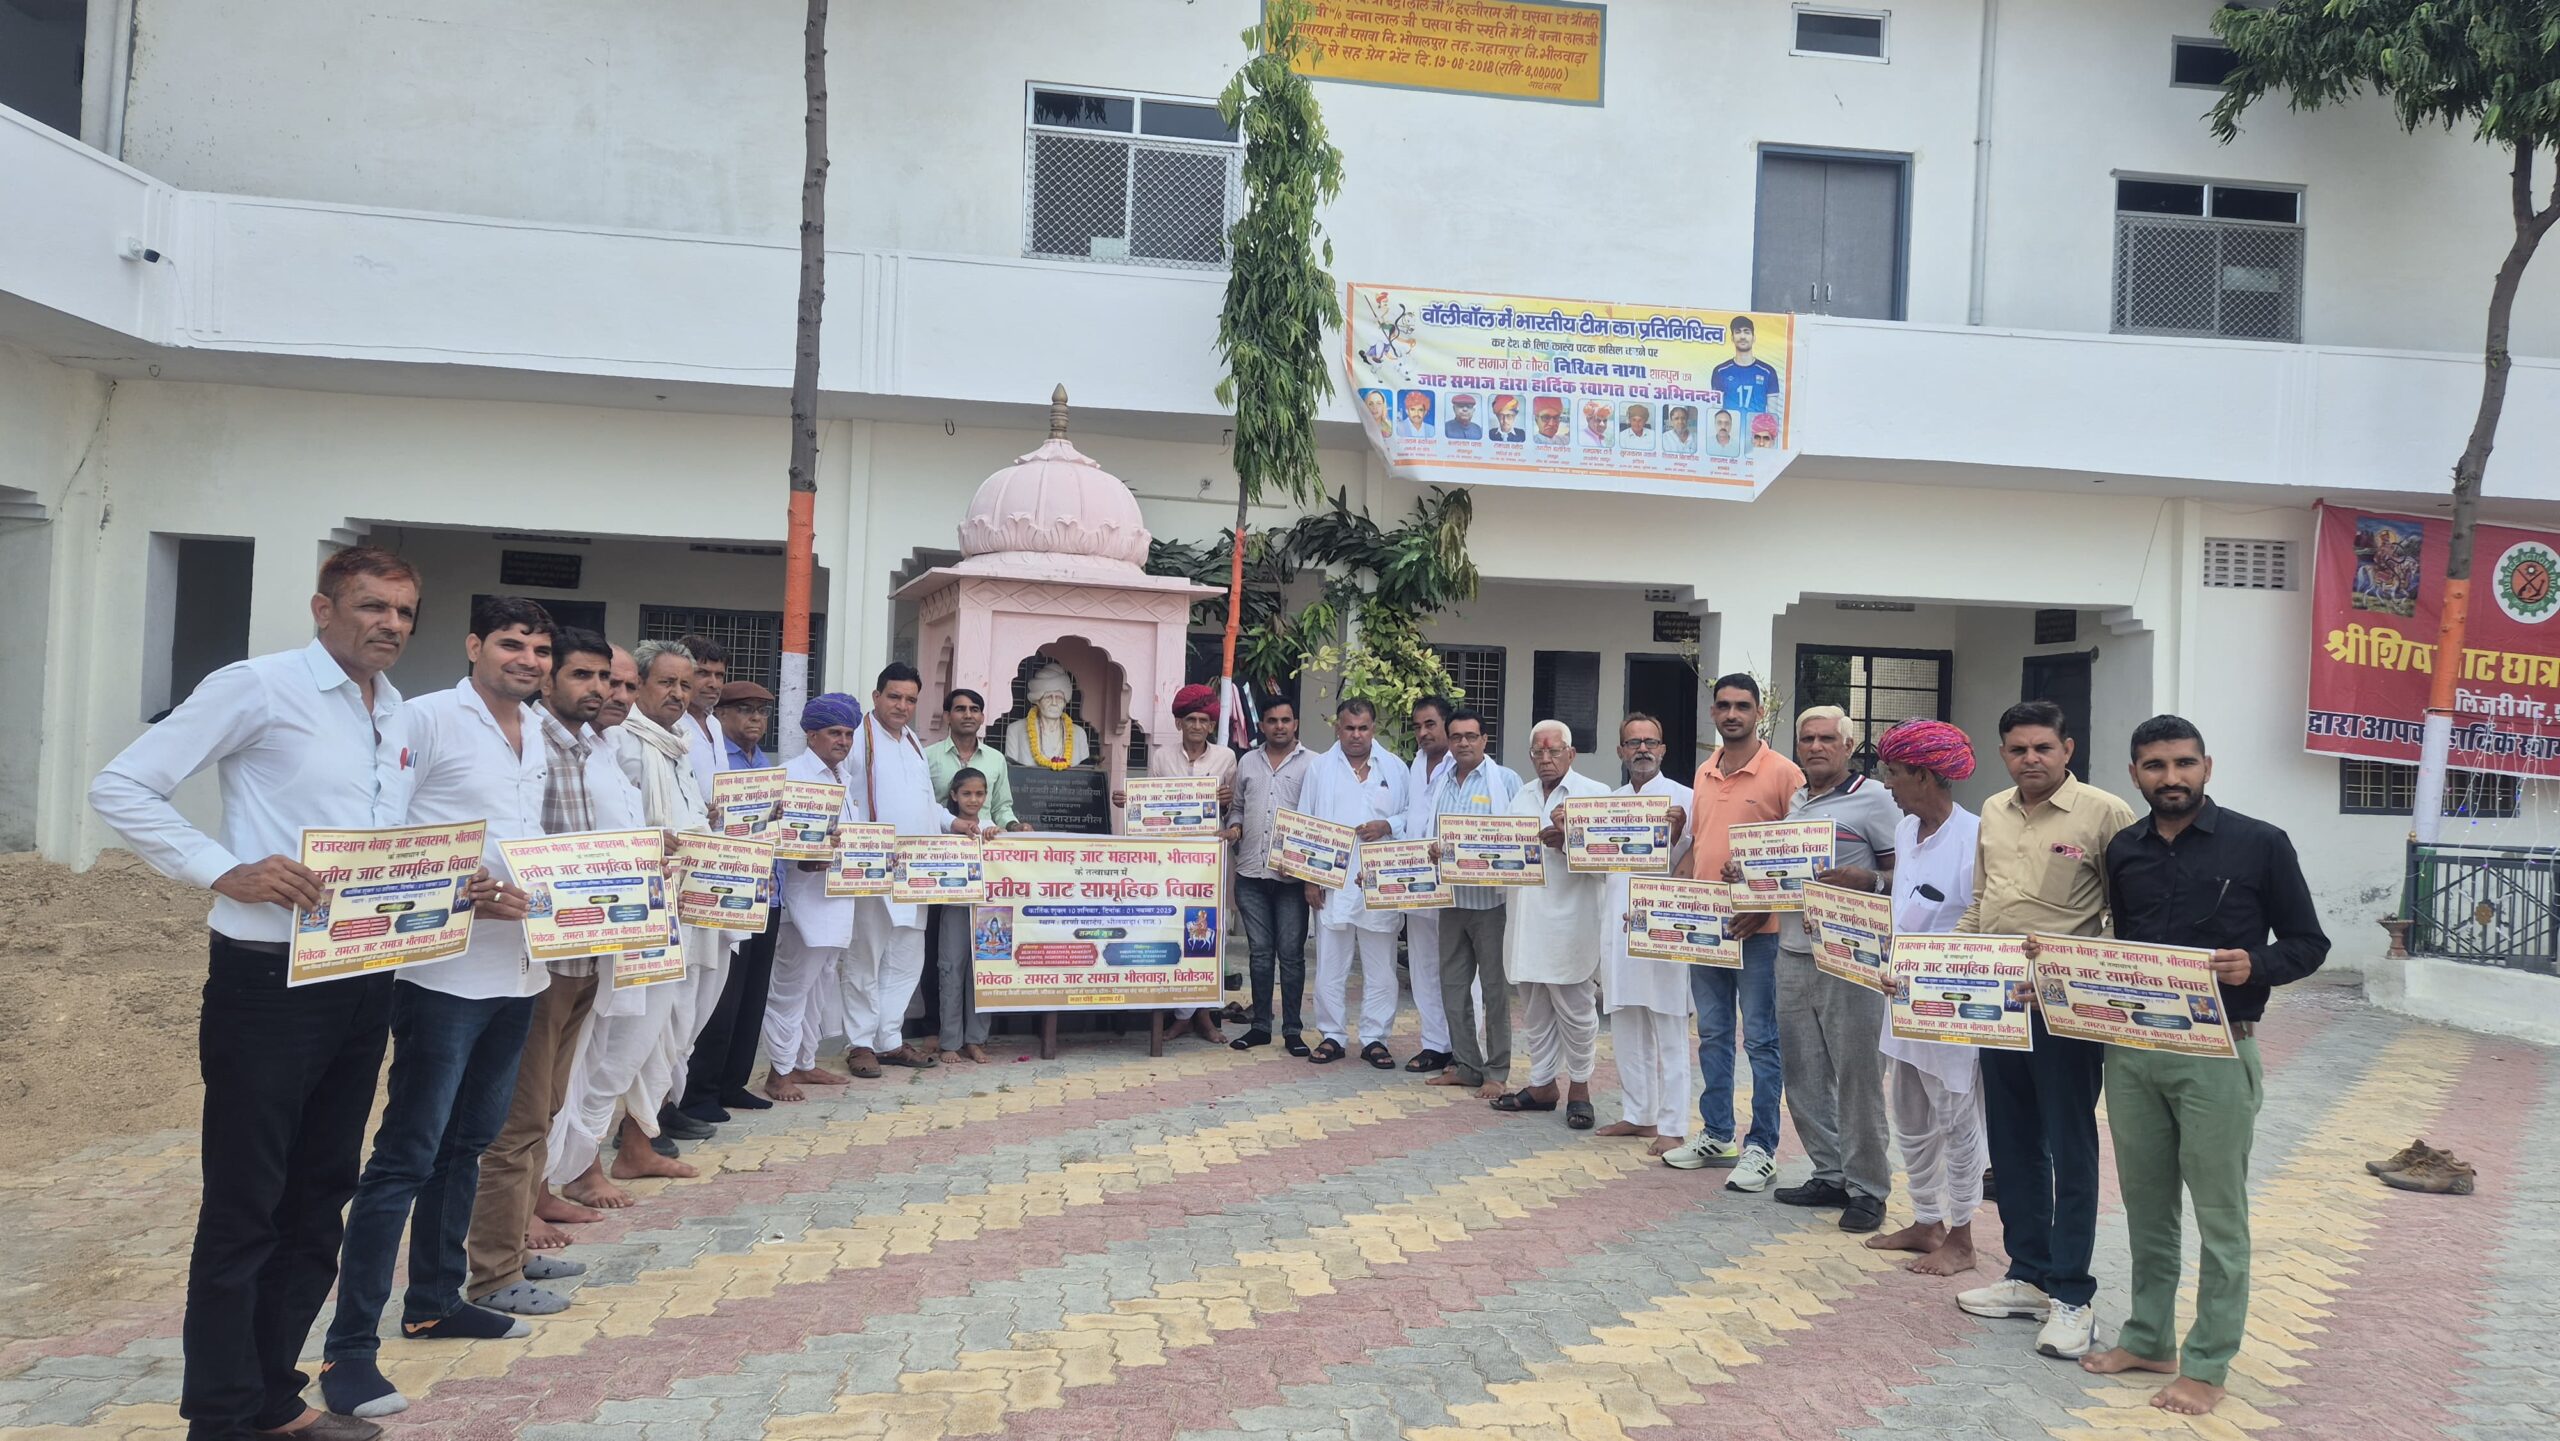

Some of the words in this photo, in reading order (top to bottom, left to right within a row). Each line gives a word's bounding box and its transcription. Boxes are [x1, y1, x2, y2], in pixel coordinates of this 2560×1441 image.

[1502, 5, 1518, 20] जी
[1335, 23, 1349, 38] जी
[1375, 13, 1400, 26] लाल
[1401, 11, 1417, 28] जी
[1455, 19, 1474, 34] की
[1510, 24, 1521, 38] में
[1563, 32, 1584, 46] लाल
[1585, 32, 1598, 47] जी
[1422, 303, 1495, 329] वॉलीबॉल
[1497, 304, 1514, 329] में
[1516, 309, 1576, 334] भारतीय
[1578, 312, 1610, 336] टीम
[1612, 319, 1636, 338] का
[1637, 317, 1726, 344] प्रतिनिधित्व
[1492, 338, 1505, 348] कर
[1522, 338, 1532, 350] के
[1457, 356, 1475, 369] जाट
[1478, 357, 1509, 370] समाज
[1511, 356, 1523, 371] के
[1553, 356, 1608, 377] निखिल
[1611, 362, 1647, 379] नागा
[1418, 373, 1448, 388] जाट
[1450, 374, 1497, 391] समाज
[1499, 376, 1530, 393] द्वारा
[1531, 375, 1577, 395] हार्दिक
[1579, 382, 1625, 398] स्वागत
[1653, 385, 1722, 405] अभिनन्दन
[1737, 385, 1753, 408] 17
[312, 840, 365, 854] राजस्थान
[395, 836, 412, 849] जाट
[983, 849, 1038, 863] राजस्थान
[1043, 845, 1075, 866] मेवाड़
[1079, 851, 1104, 863] जाट
[1108, 850, 1161, 866] महासभा,
[1167, 848, 1217, 866] भीलवाड़ा
[356, 866, 386, 882] जाट
[388, 858, 444, 881] सामूहिक
[447, 854, 479, 873] विवाह
[555, 862, 581, 876] जाट
[1038, 882, 1075, 899] जाट
[1080, 878, 1159, 904] सामूहिक
[1165, 878, 1216, 899] विवाह
[2102, 950, 2119, 961] जाट
[976, 970, 1012, 986] निवेदक
[1025, 974, 1059, 985] समस्त
[1063, 973, 1084, 984] जाट
[1088, 972, 1120, 984] समाज
[1894, 959, 1920, 974] तृतीय
[1923, 961, 1943, 973] जाट
[1946, 961, 1990, 977] सामूहिक
[1993, 962, 2026, 978] विवाह
[2037, 962, 2072, 980] तृतीय
[2076, 966, 2102, 980] जाट
[2105, 968, 2163, 989] सामूहिक
[2168, 975, 2209, 994] विवाह
